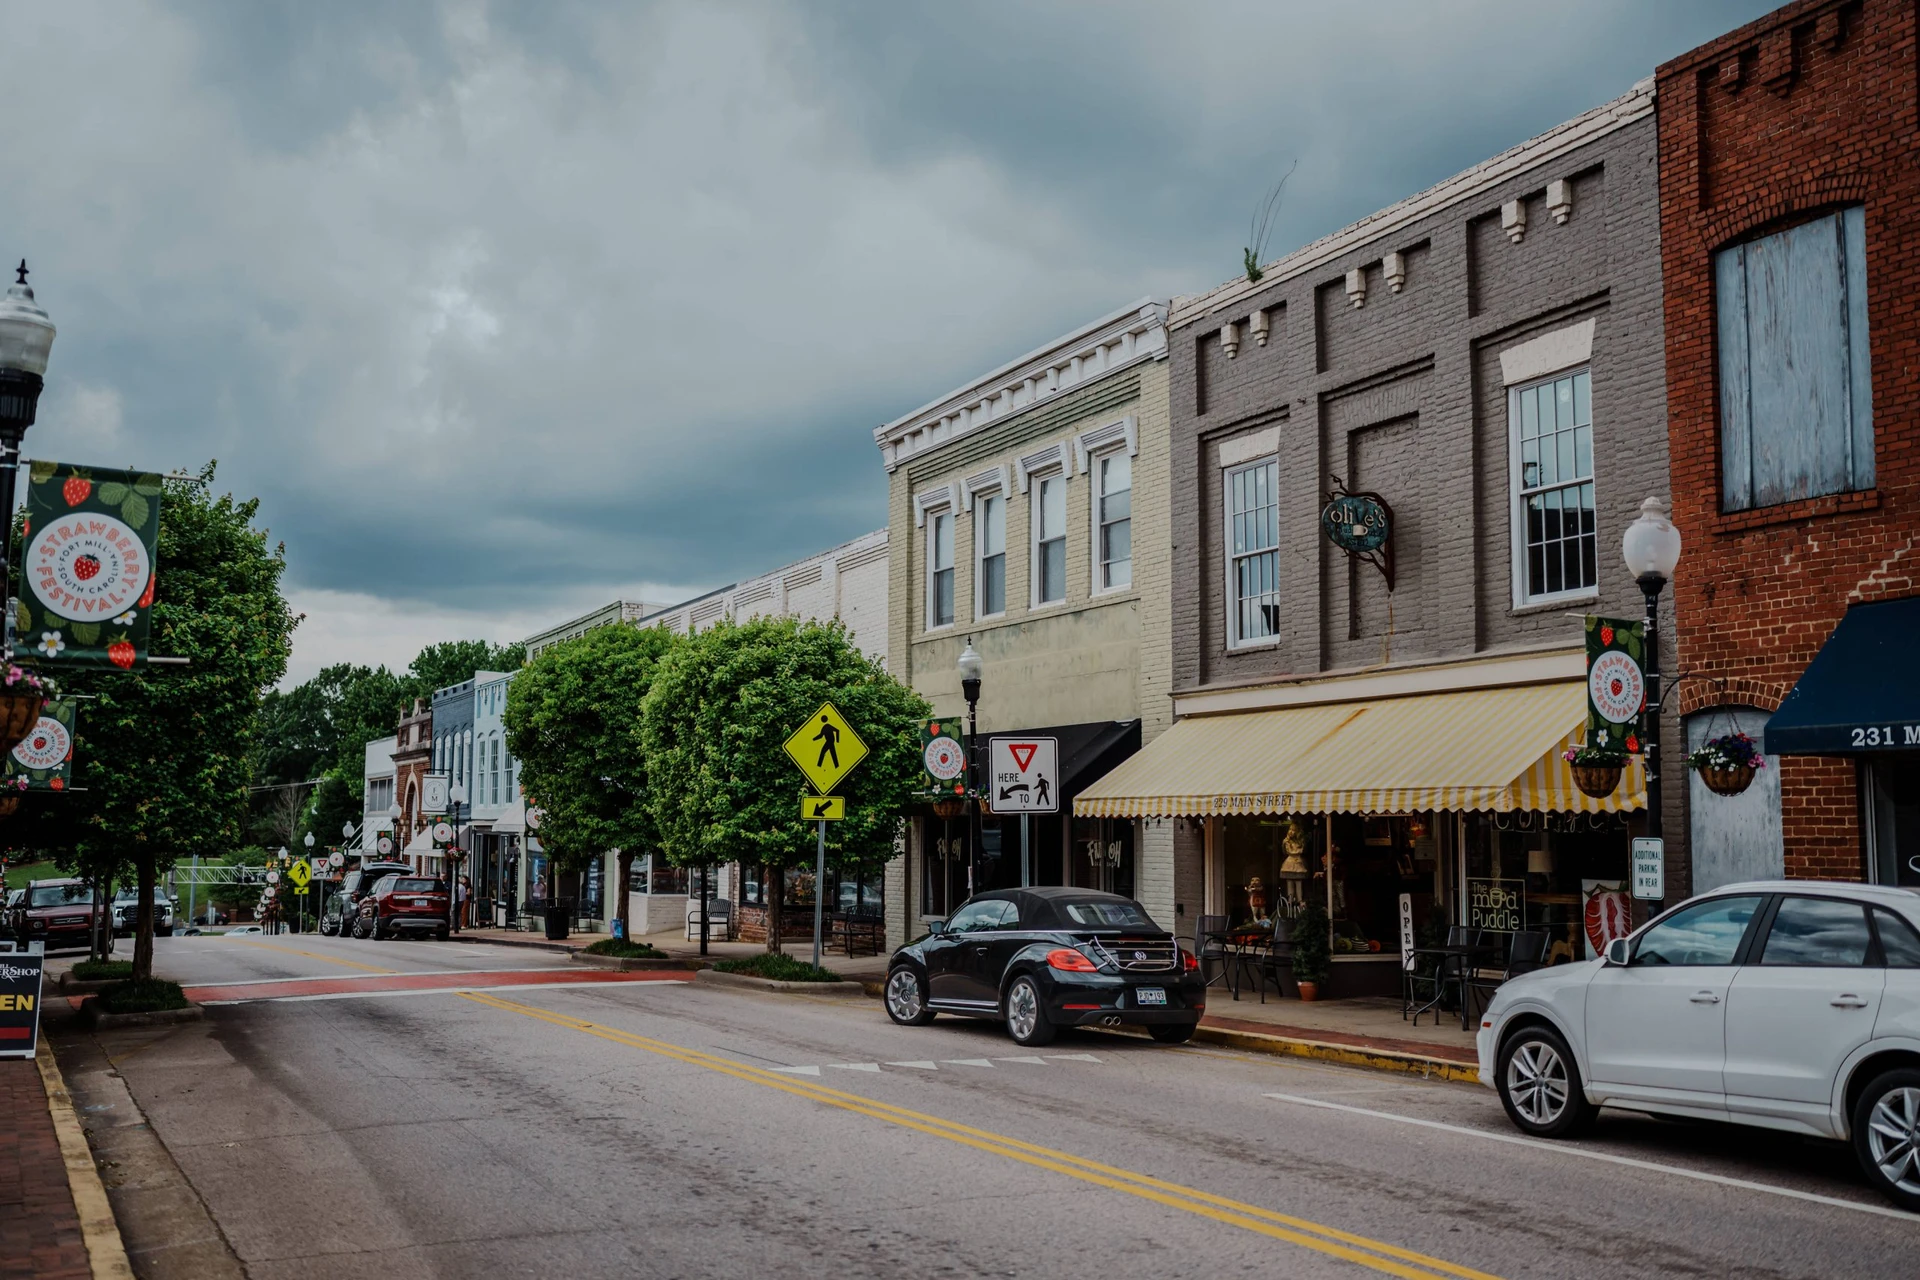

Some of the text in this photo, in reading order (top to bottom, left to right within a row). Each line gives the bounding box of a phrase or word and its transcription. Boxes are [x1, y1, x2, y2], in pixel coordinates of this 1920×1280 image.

[40, 520, 139, 589] STRAWBERRY
[60, 540, 107, 562] FORT MILL
[58, 553, 118, 594] SOUTH CAROLINA
[36, 566, 124, 613] FESTIVAL
[1595, 656, 1640, 701] STRAWBERRY
[1614, 669, 1625, 677] MILL
[1594, 687, 1634, 717] FESTIVAL
[1851, 726, 1895, 747] 231
[998, 773, 1019, 782] HERE
[1019, 794, 1030, 803] TO
[1214, 795, 1294, 808] 229 MAIN STREET
[1635, 851, 1661, 860] ADDITIONAL
[1638, 864, 1657, 874] PARKING
[1472, 882, 1487, 894] The
[1639, 878, 1657, 887] IN REAR
[1472, 908, 1519, 930] Puddle
